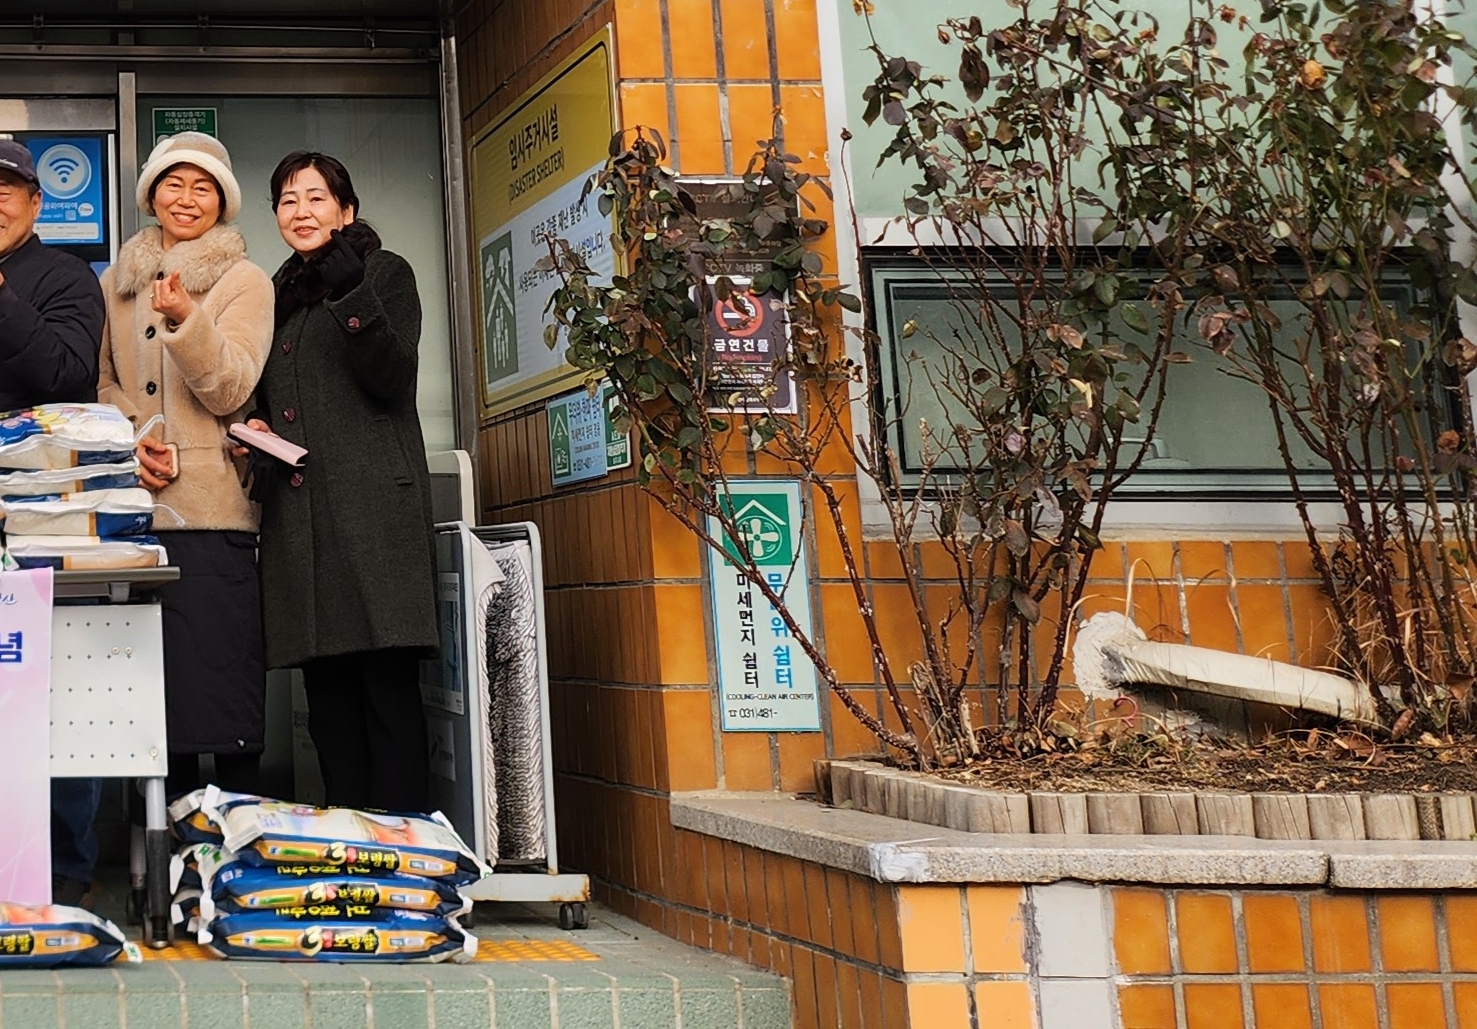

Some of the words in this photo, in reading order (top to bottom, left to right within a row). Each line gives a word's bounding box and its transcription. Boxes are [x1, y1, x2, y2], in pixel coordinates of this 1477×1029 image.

[508, 103, 559, 170] 임시주거시설
[508, 168, 536, 205] (DISASTER
[537, 146, 564, 183] SHELTER)
[41, 202, 78, 210] 공와이파이
[714, 338, 769, 352] 금연건물
[735, 573, 756, 646] 미세먼지
[768, 573, 789, 638] 무위
[742, 652, 759, 689] 쉼터
[739, 708, 778, 719] 031)481-
